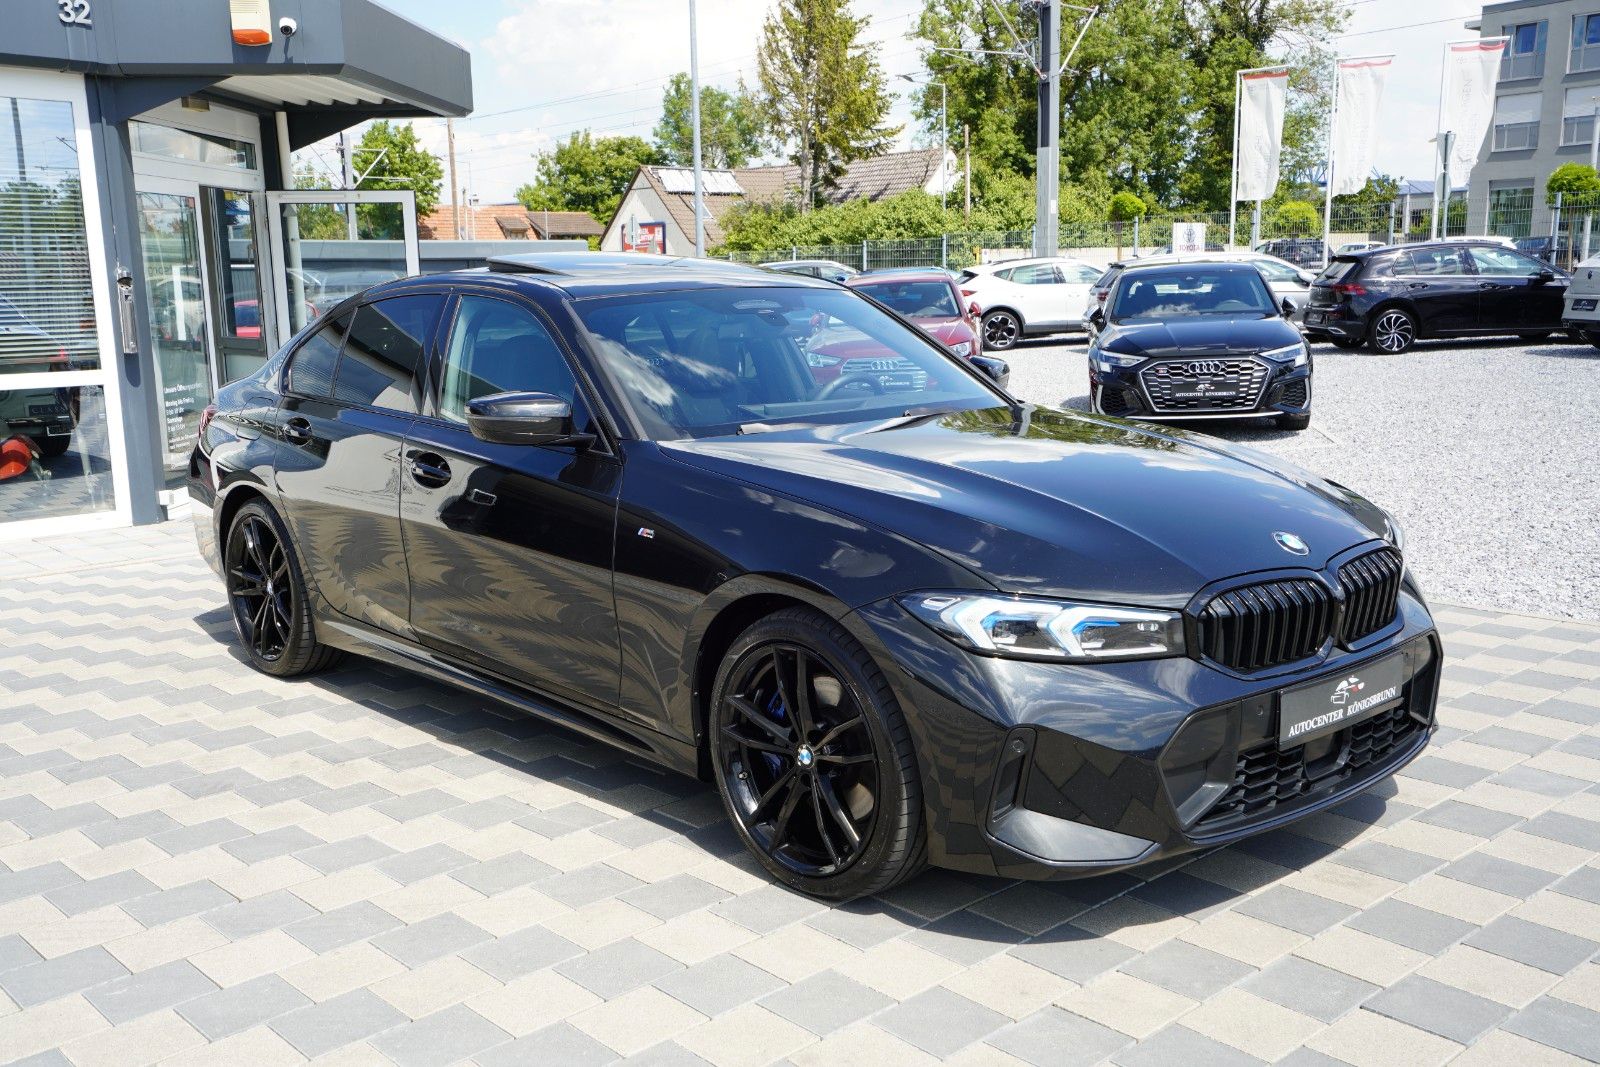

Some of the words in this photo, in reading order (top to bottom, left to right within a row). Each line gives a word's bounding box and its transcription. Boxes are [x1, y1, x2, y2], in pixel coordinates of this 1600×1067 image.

[58, 0, 92, 24] 32
[1288, 709, 1344, 737] AUTOCENTER
[1347, 687, 1396, 716] KÖNIGSBRUNN
